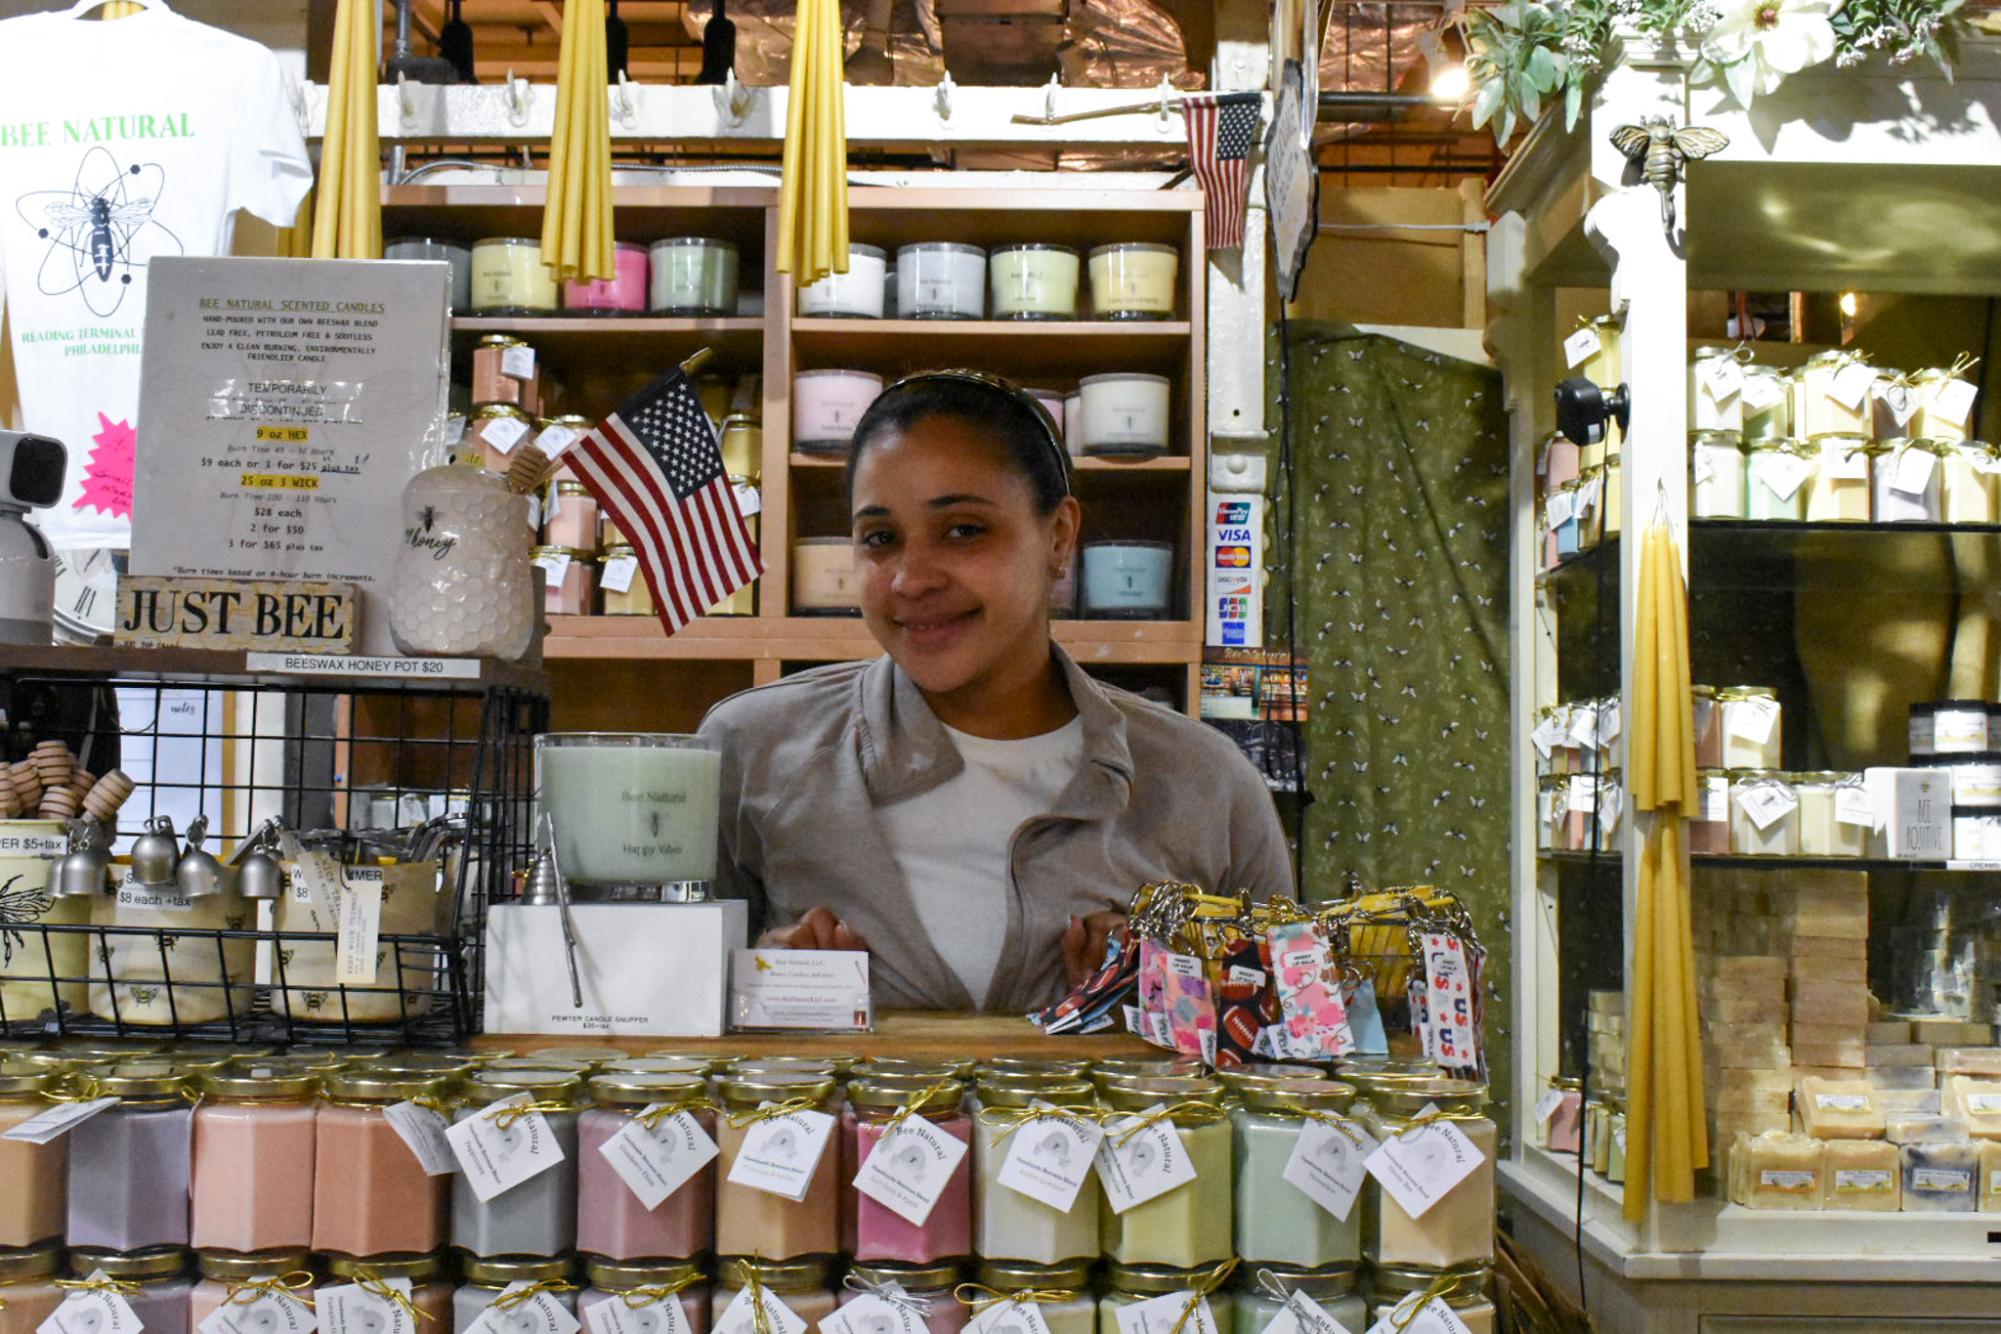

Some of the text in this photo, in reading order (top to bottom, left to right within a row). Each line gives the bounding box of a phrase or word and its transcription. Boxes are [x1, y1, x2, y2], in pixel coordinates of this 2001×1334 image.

[1, 112, 196, 147] BEE NATURAL
[199, 299, 386, 313] BEE NATURAL SCENTED CANDLES
[258, 317, 277, 325] WITH
[298, 318, 314, 326] OWN
[317, 318, 350, 327] BEESWAX
[354, 320, 379, 328] BLEND
[22, 327, 136, 343] READING TERMINAL
[207, 329, 225, 337] LEAD
[256, 330, 298, 338] PETROLEUM
[302, 331, 321, 339] FREE
[334, 332, 373, 341] SOOTLESS
[65, 343, 140, 356] PHILADELPHI
[201, 342, 223, 350] ENJOY
[236, 343, 260, 351] CLEAN
[305, 345, 376, 355] ENVIRONMENTALLY
[298, 354, 326, 363] CANDLE
[257, 429, 308, 440] 9 oz HEX
[218, 458, 242, 468] each
[277, 460, 294, 470] for
[300, 460, 317, 471] $25
[321, 463, 341, 473] plus
[240, 475, 254, 486] 25
[260, 478, 273, 487] oz
[292, 478, 318, 488] WICK
[254, 507, 302, 518] $28 each
[263, 523, 280, 533] for
[286, 524, 304, 535] $50
[1218, 529, 1251, 541] VISA
[240, 539, 258, 549] for
[264, 540, 281, 550] $65
[286, 543, 305, 553] plus
[256, 570, 266, 578] on
[124, 590, 343, 639] JUST BEE
[285, 658, 444, 674] BEESWAX HONEY POT $20
[1917, 799, 1932, 824] BEE
[23, 838, 61, 850] $5+tax
[120, 892, 191, 907] $8 each +tax
[296, 887, 309, 899] $8
[552, 1015, 649, 1024] PEWTER CANDLE SNUFFER
[896, 1125, 949, 1161] Bee Natural
[1441, 1127, 1466, 1163] Natural
[1157, 1132, 1172, 1174] Natural
[103, 1293, 121, 1331] Natural
[275, 1295, 298, 1331] Natural
[534, 1295, 558, 1332] Natural
